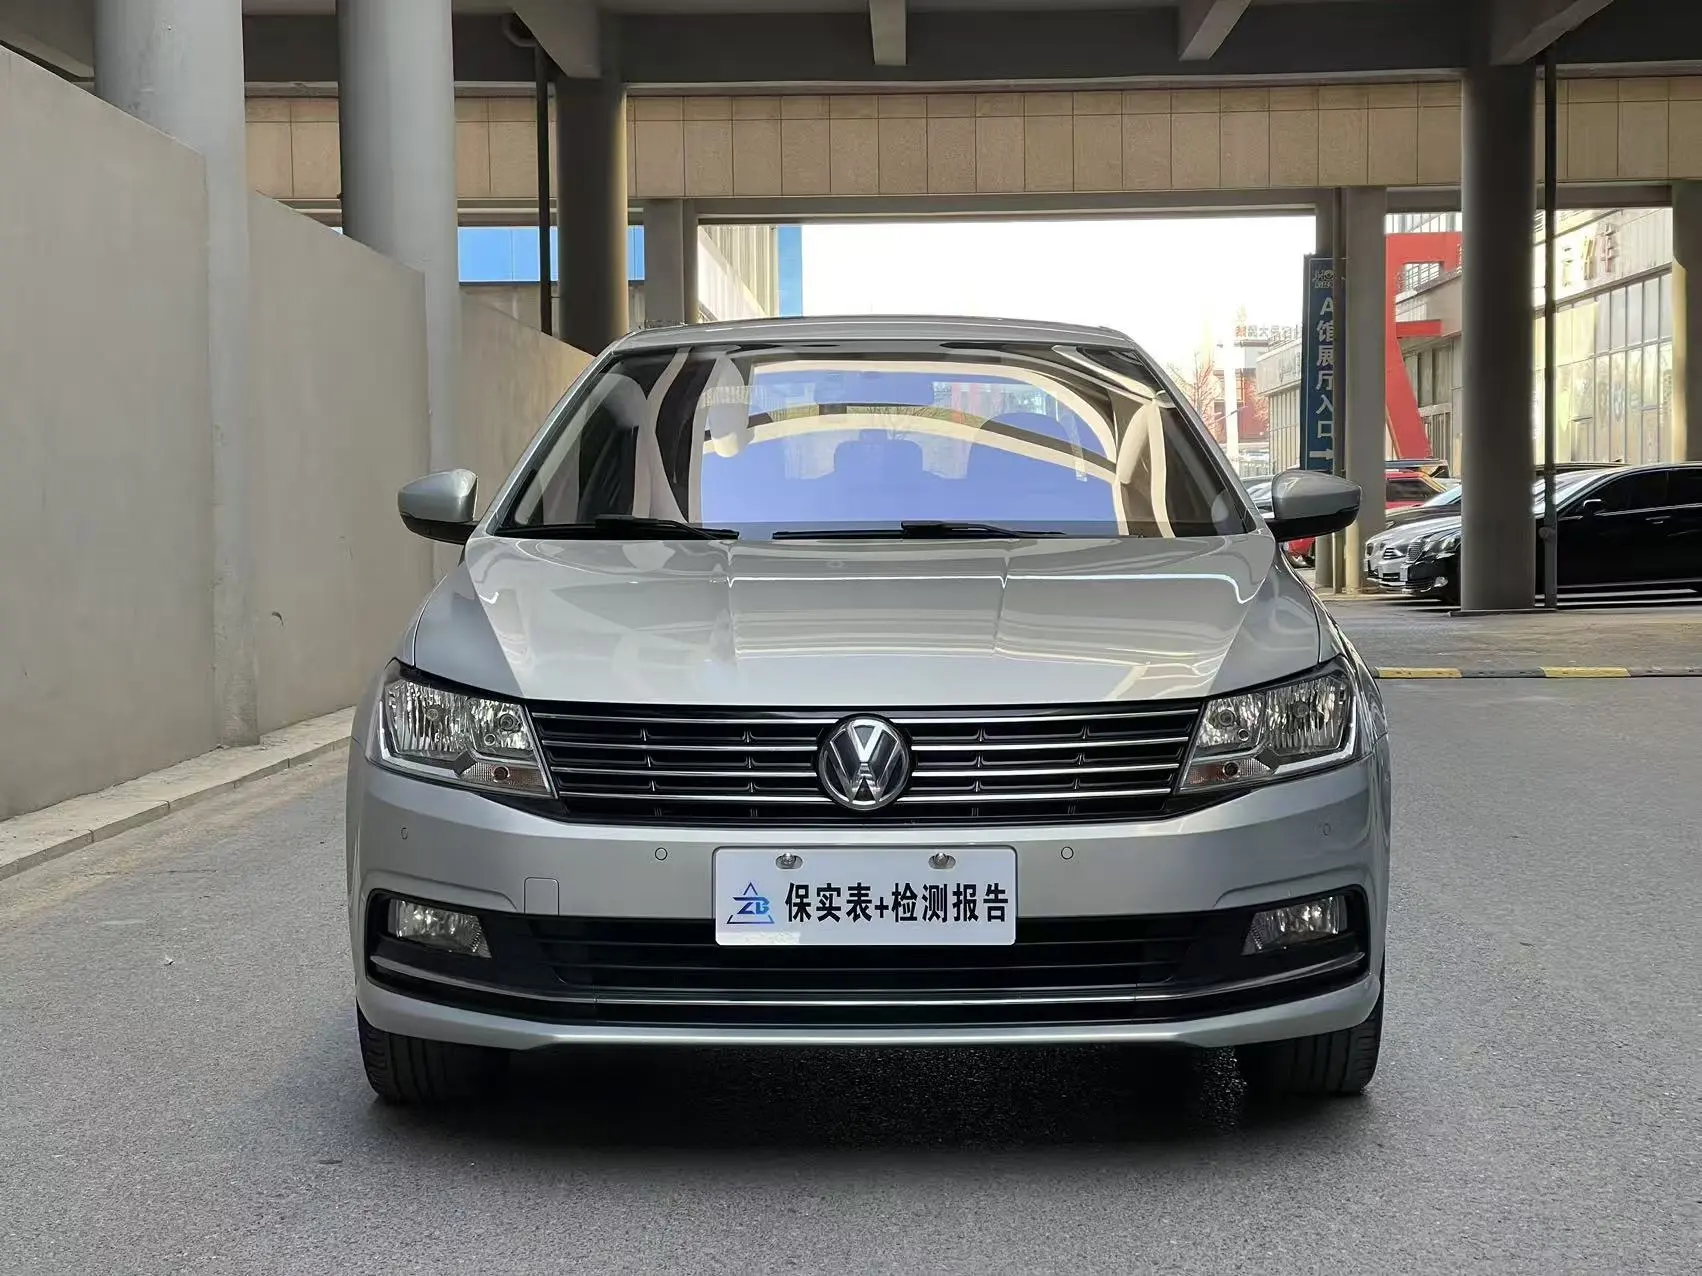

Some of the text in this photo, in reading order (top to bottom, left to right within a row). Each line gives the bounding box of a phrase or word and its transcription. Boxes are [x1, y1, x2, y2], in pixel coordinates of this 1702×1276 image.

[784, 881, 1009, 924] 保实表+检测报告
